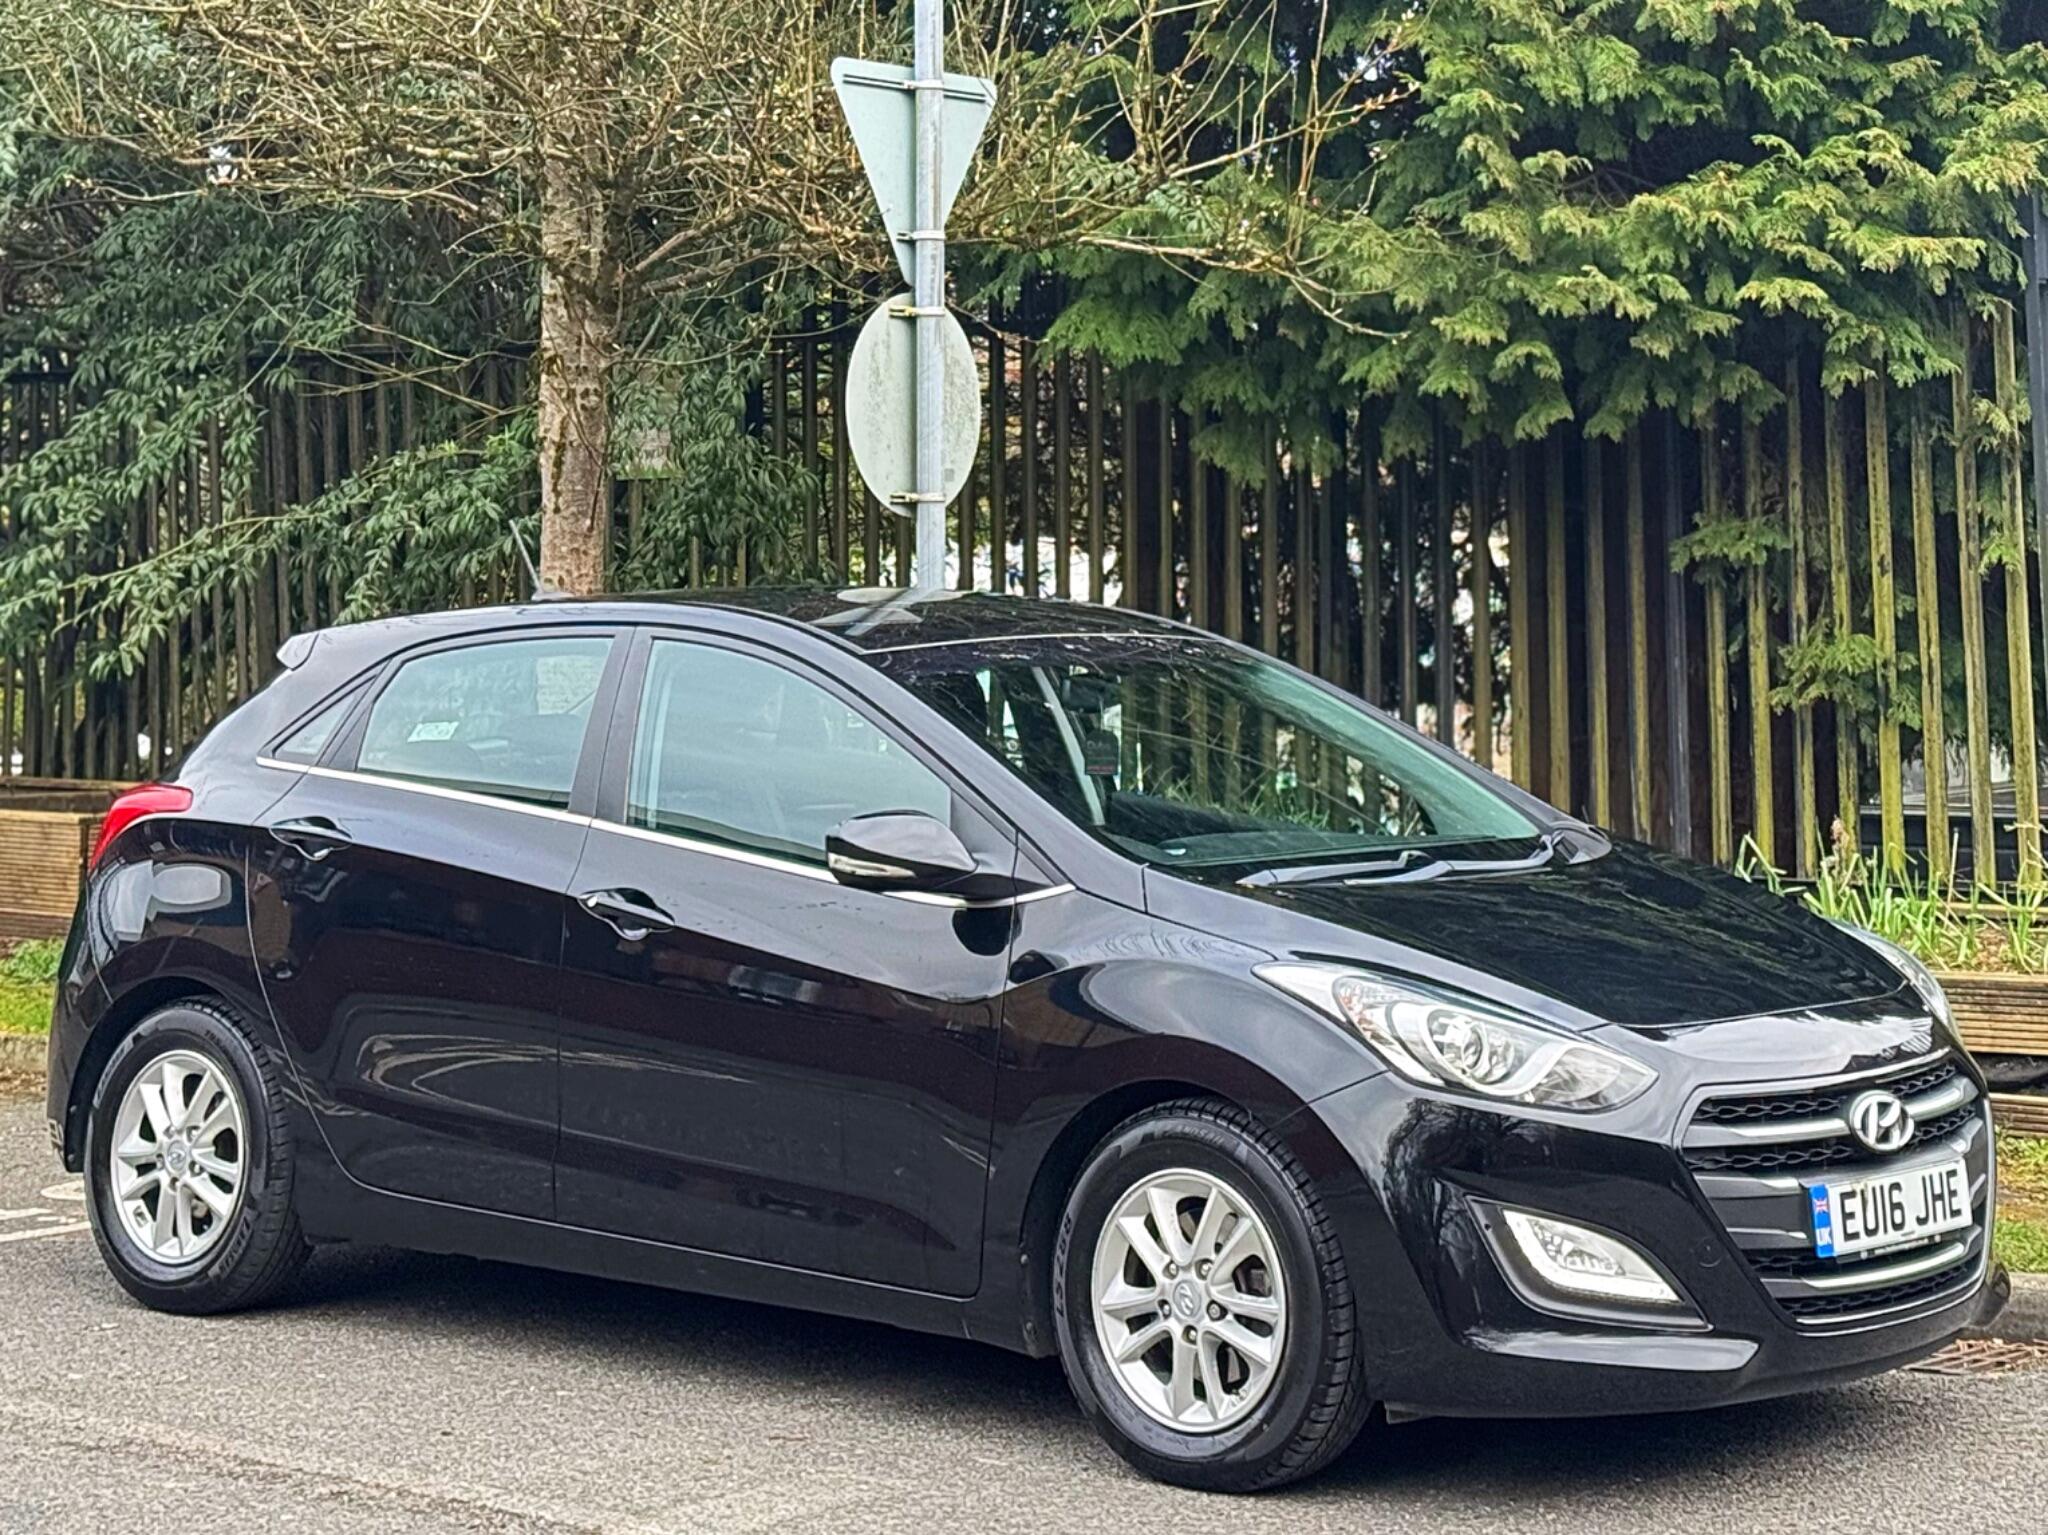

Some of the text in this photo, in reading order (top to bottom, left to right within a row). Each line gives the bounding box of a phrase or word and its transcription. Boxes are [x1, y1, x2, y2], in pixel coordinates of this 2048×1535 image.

[1839, 1168, 1963, 1243] EU16 JHE
[1815, 1227, 1832, 1246] UK
